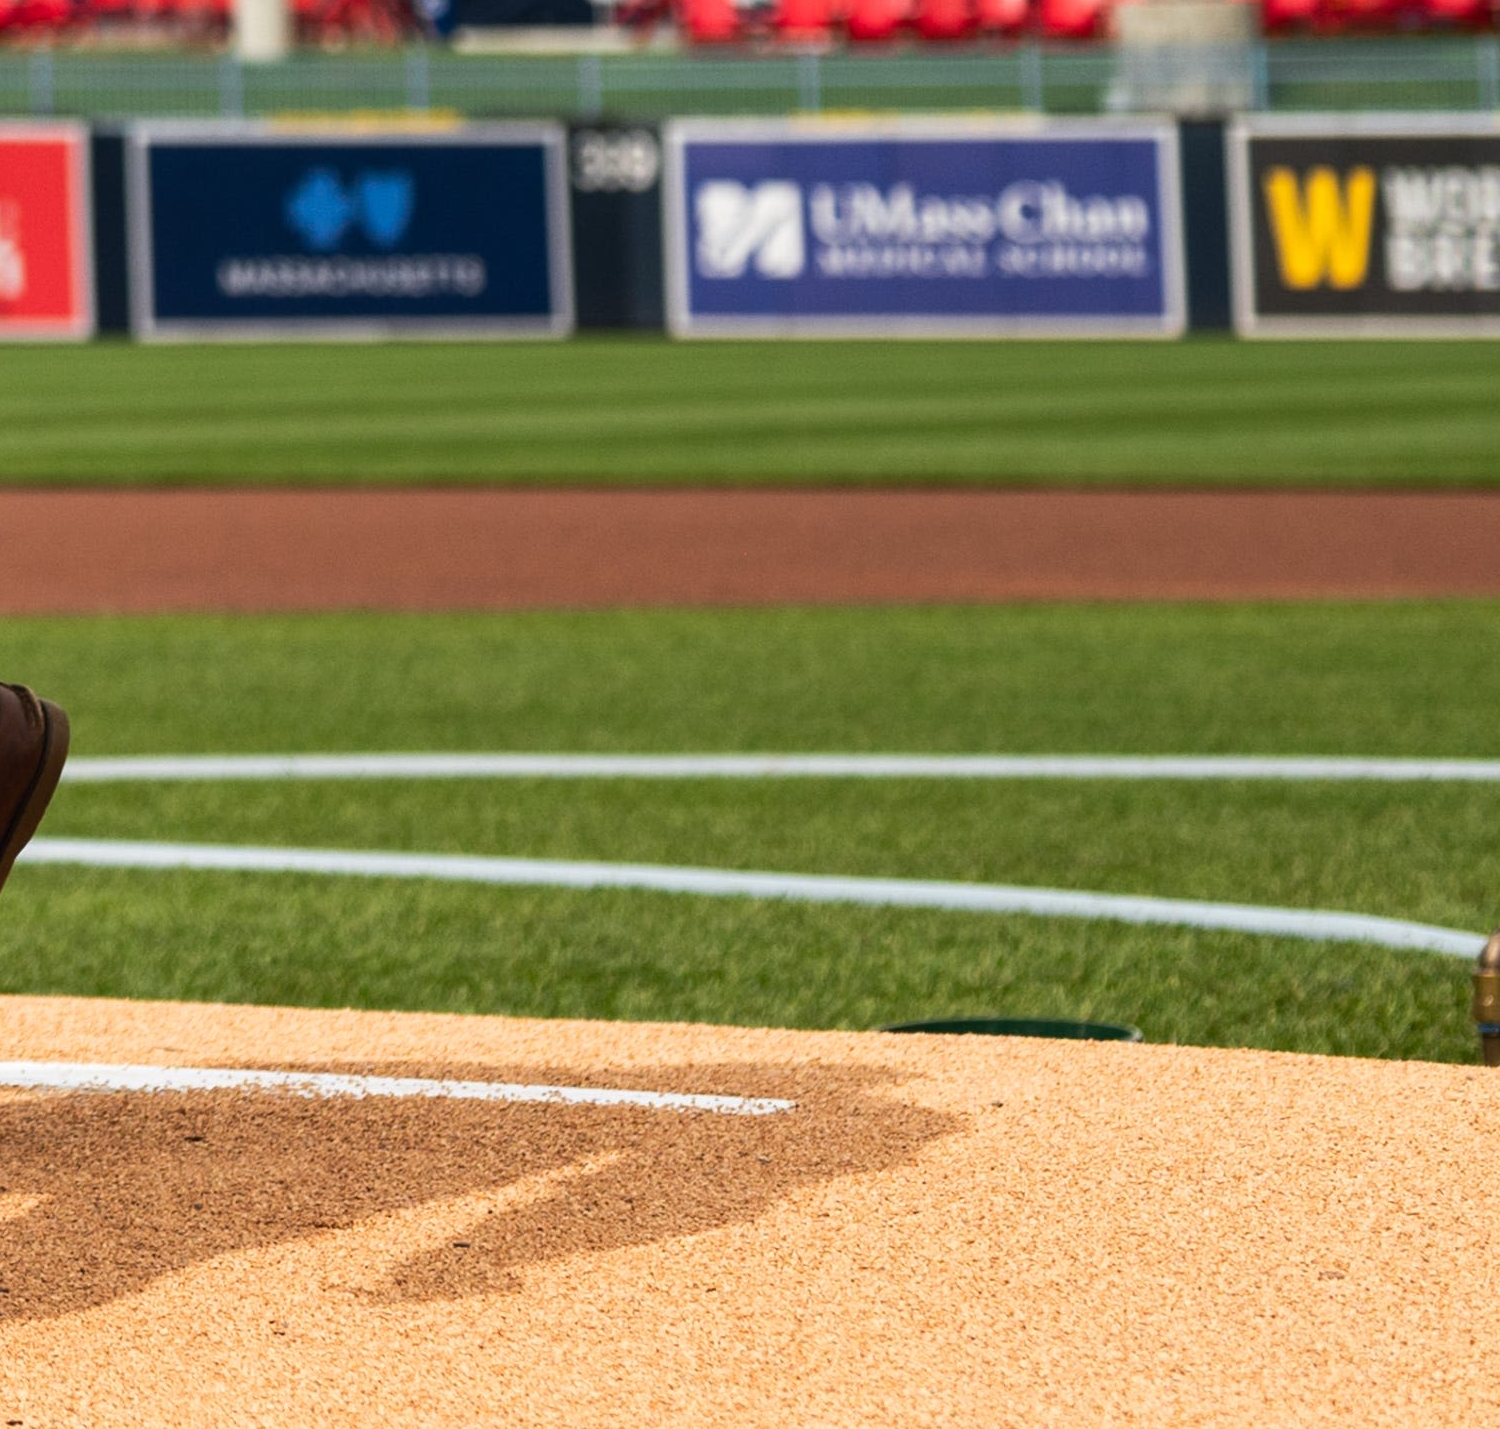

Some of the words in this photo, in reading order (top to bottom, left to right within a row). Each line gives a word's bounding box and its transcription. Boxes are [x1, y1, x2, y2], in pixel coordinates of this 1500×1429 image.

[811, 181, 995, 241] UMass
[998, 180, 1149, 241] Chan
[217, 254, 486, 300] MASSACHUSETTS
[815, 241, 988, 278] MEDICAL
[999, 241, 1151, 278] SCHOOL
[1384, 233, 1500, 293] BRE
